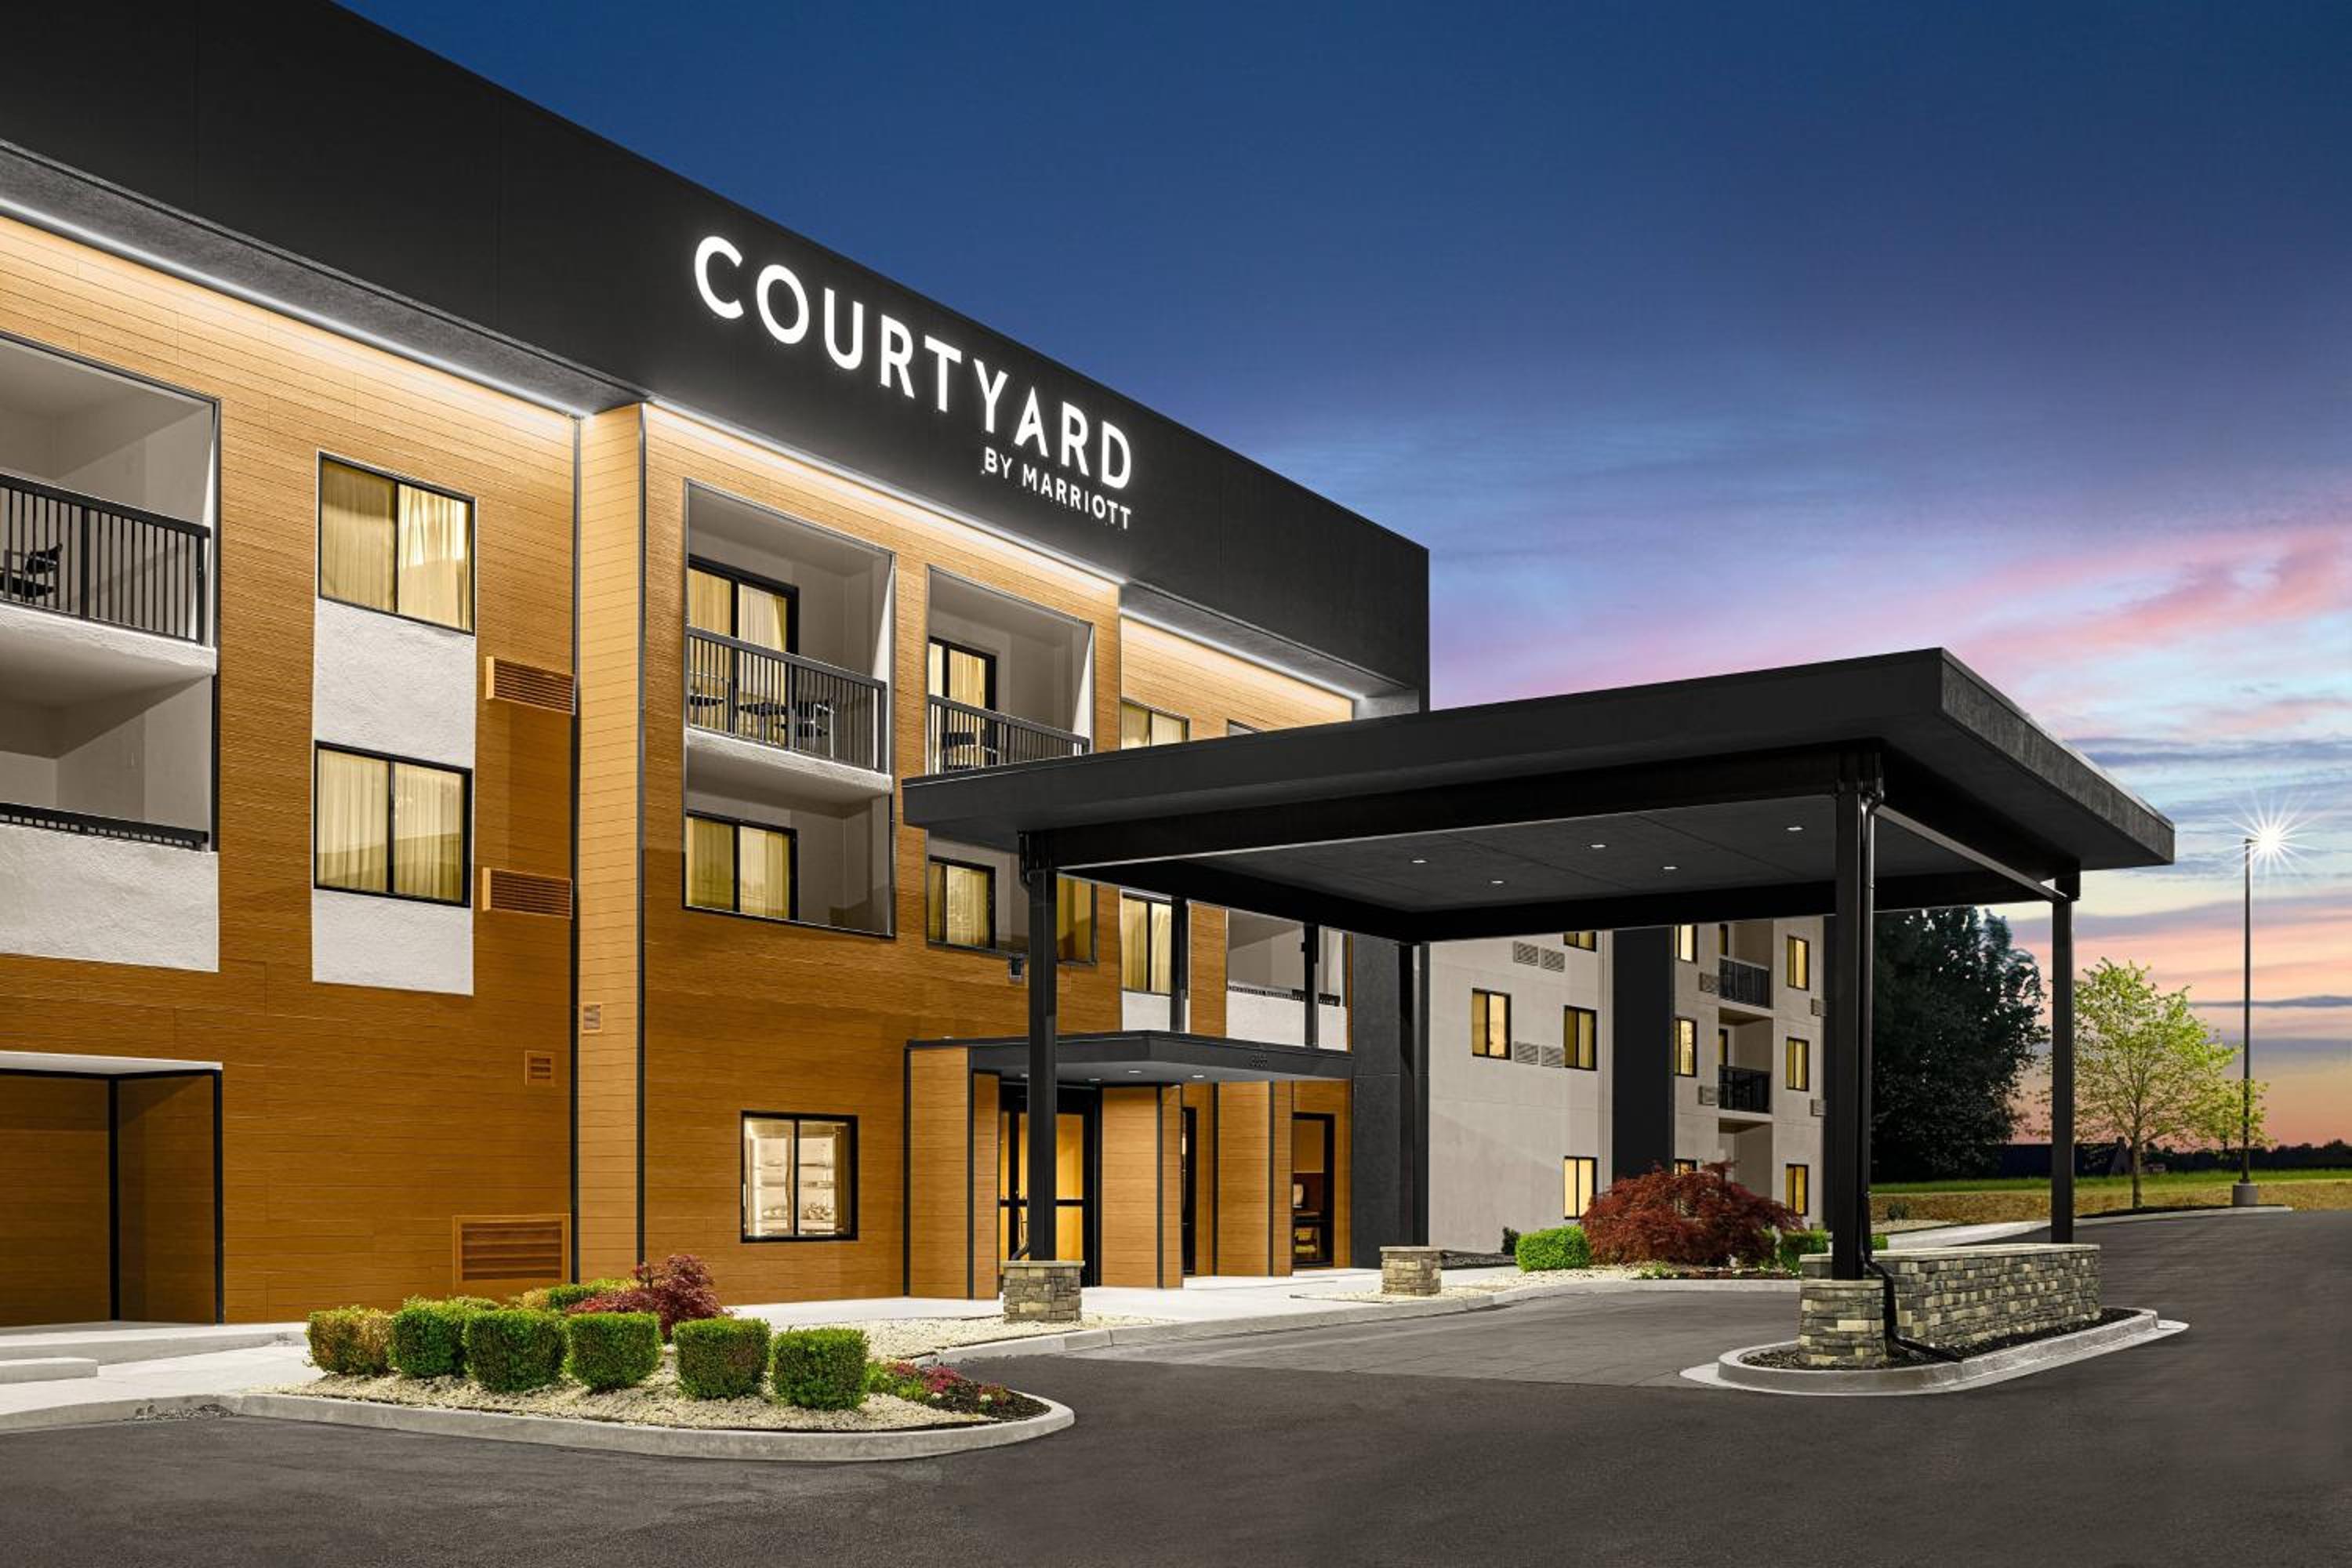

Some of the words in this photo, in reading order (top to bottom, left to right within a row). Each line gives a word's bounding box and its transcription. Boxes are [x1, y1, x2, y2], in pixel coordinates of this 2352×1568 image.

[694, 236, 1131, 489] COURTYARD
[984, 446, 1013, 479] BY
[1022, 463, 1131, 529] MARRIOTT
